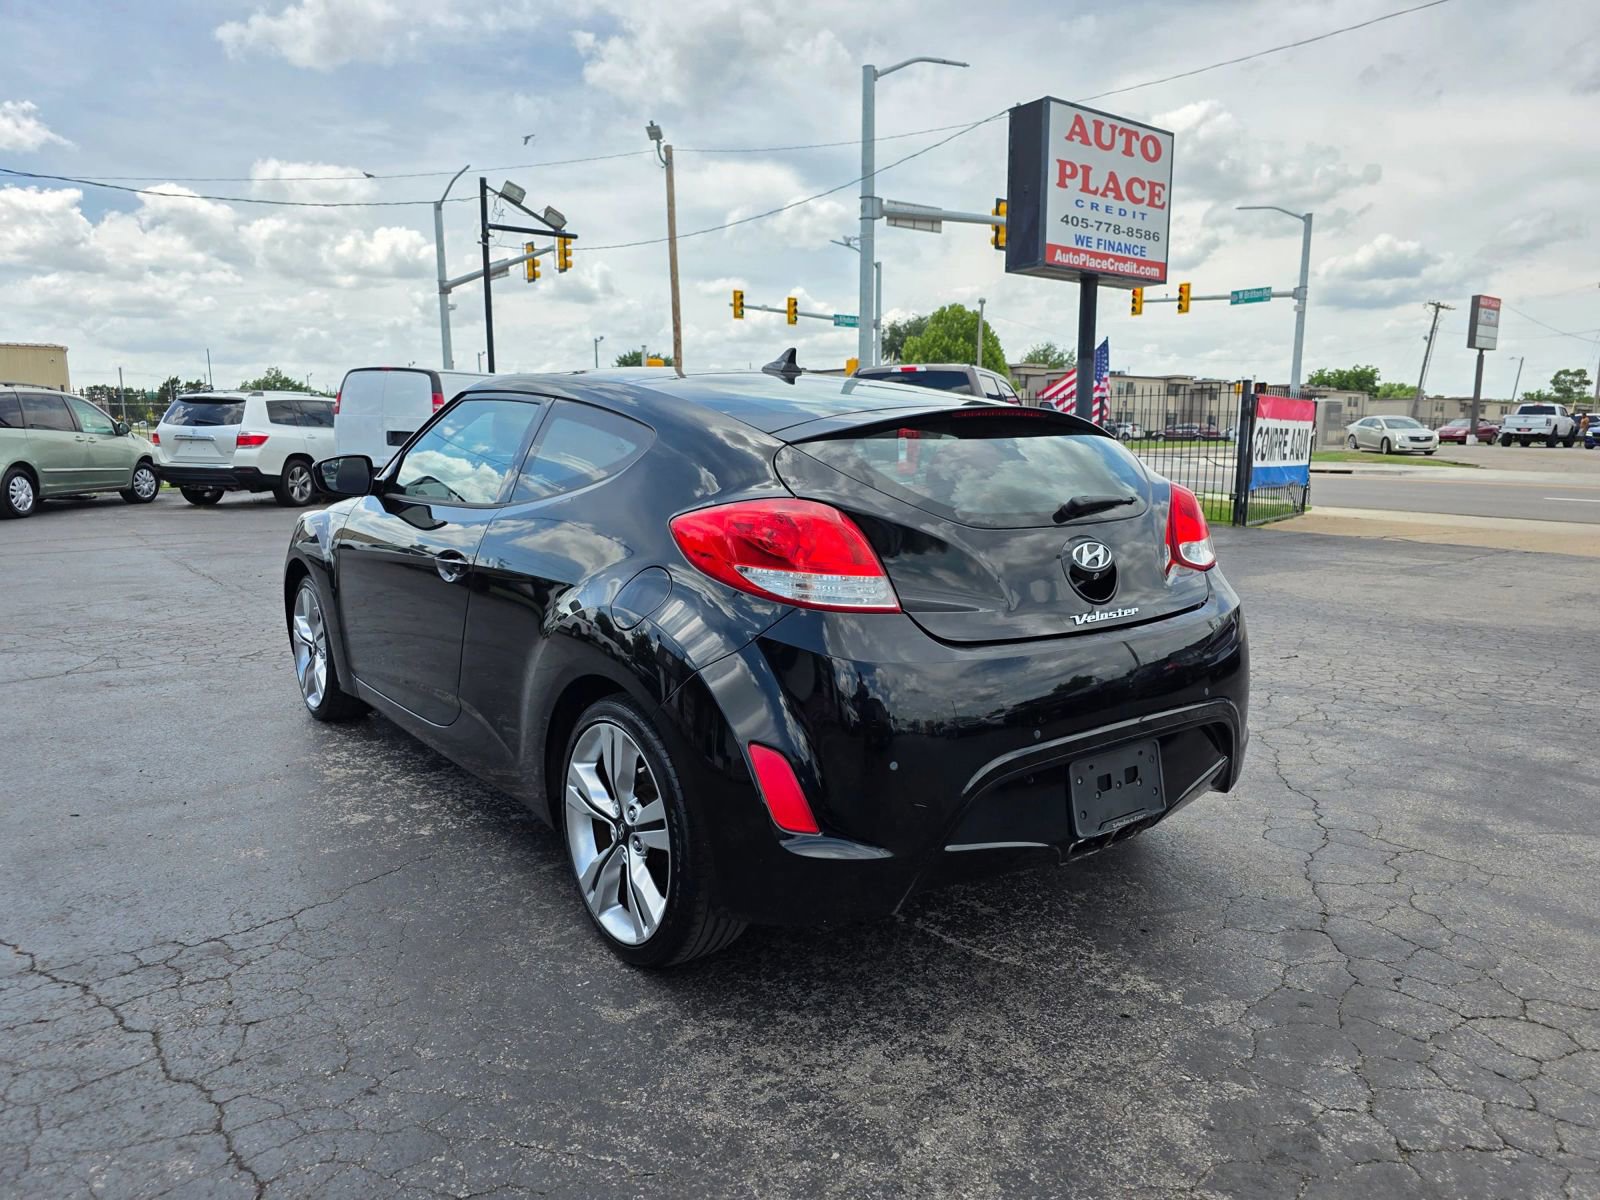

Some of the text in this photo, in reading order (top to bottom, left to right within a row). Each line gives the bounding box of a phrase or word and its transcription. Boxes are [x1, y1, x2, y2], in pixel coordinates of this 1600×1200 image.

[1065, 113, 1162, 163] AUTO
[1056, 158, 1166, 210] PLACE
[1075, 199, 1148, 221] CREDIT
[1060, 214, 1161, 242] 405-778-8586
[1074, 233, 1147, 258] WE FINANCE
[1054, 248, 1160, 277] AutoPlaceCredit.com
[1069, 607, 1139, 626] Veloster
